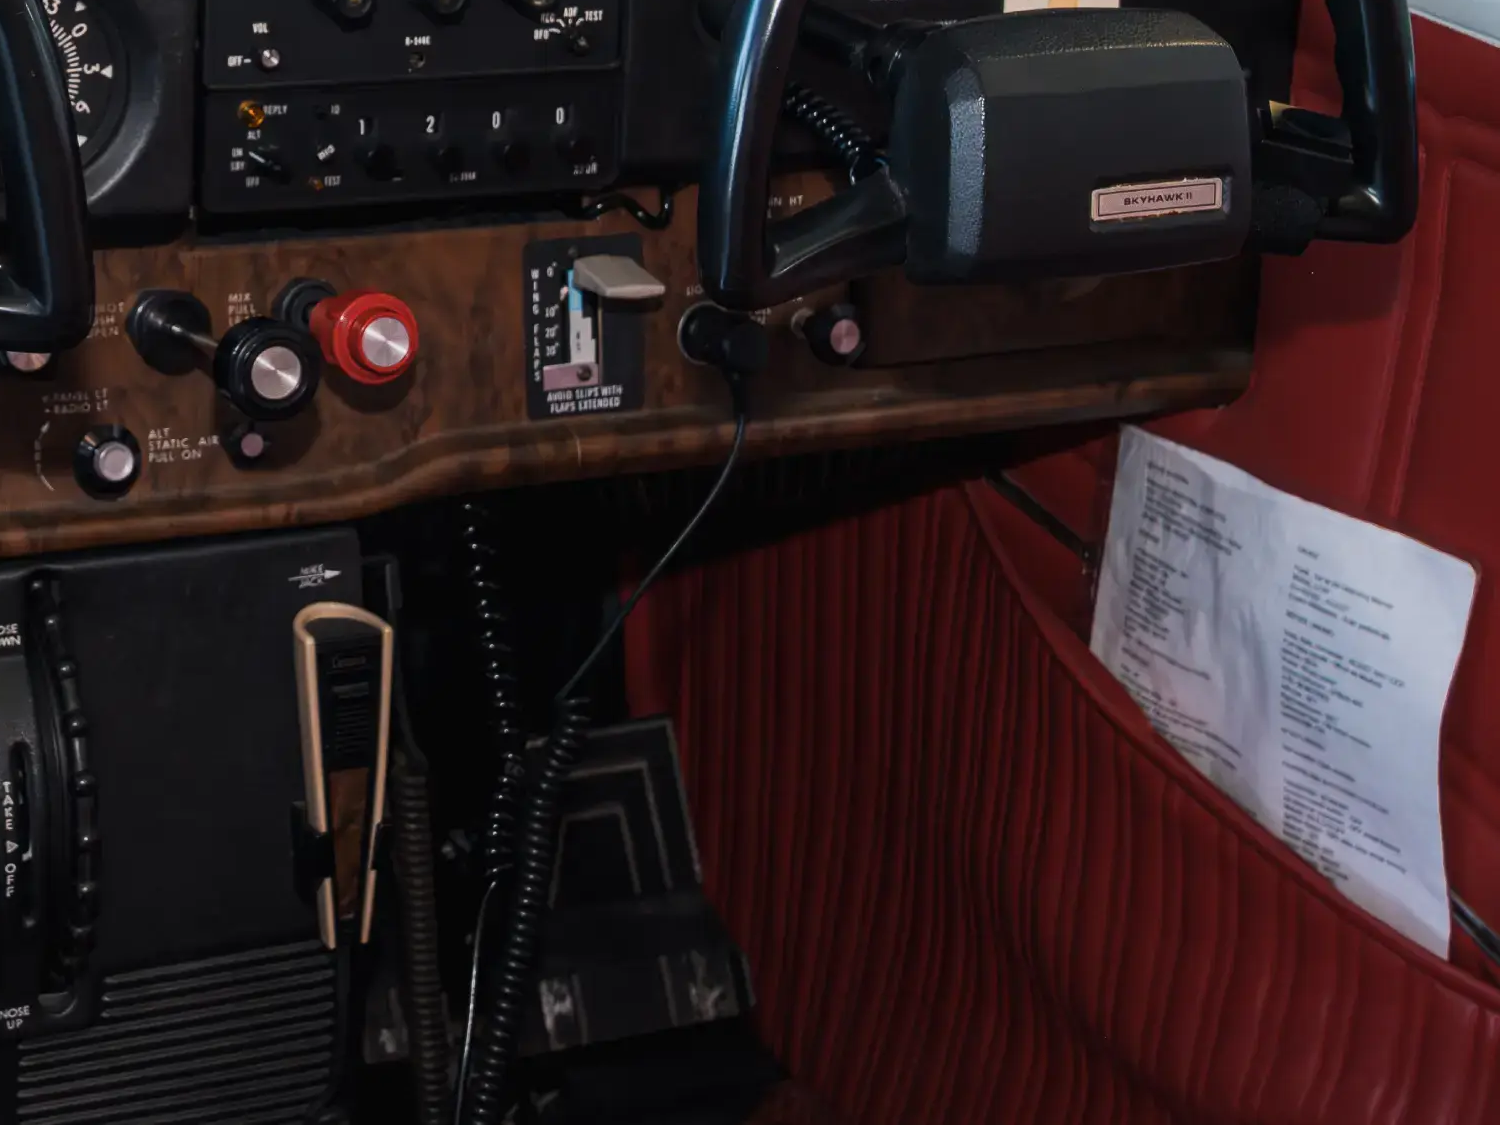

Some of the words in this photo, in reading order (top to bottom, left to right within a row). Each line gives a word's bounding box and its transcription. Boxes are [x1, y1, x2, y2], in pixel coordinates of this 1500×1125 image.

[1123, 193, 1184, 206] SKYHAWK
[228, 293, 251, 302] MIX
[531, 269, 540, 315] WING
[228, 304, 256, 315] PULL
[533, 323, 541, 382] FLAPS
[547, 388, 573, 402] AVOID
[575, 387, 599, 400] SLIPS
[600, 384, 623, 396] WITH
[54, 404, 91, 415] RADIO
[550, 399, 576, 413] FLAPS
[578, 395, 621, 411] EXTENDED
[149, 428, 170, 440] ALT
[149, 438, 188, 451] STATIC
[199, 435, 220, 446] AIR
[149, 451, 175, 463] PULL
[181, 449, 201, 461] ON
[2, 781, 14, 831] TAKE
[5, 863, 17, 898] OFF
[0, 1005, 30, 1019] NOSE
[6, 1019, 23, 1030] UP
